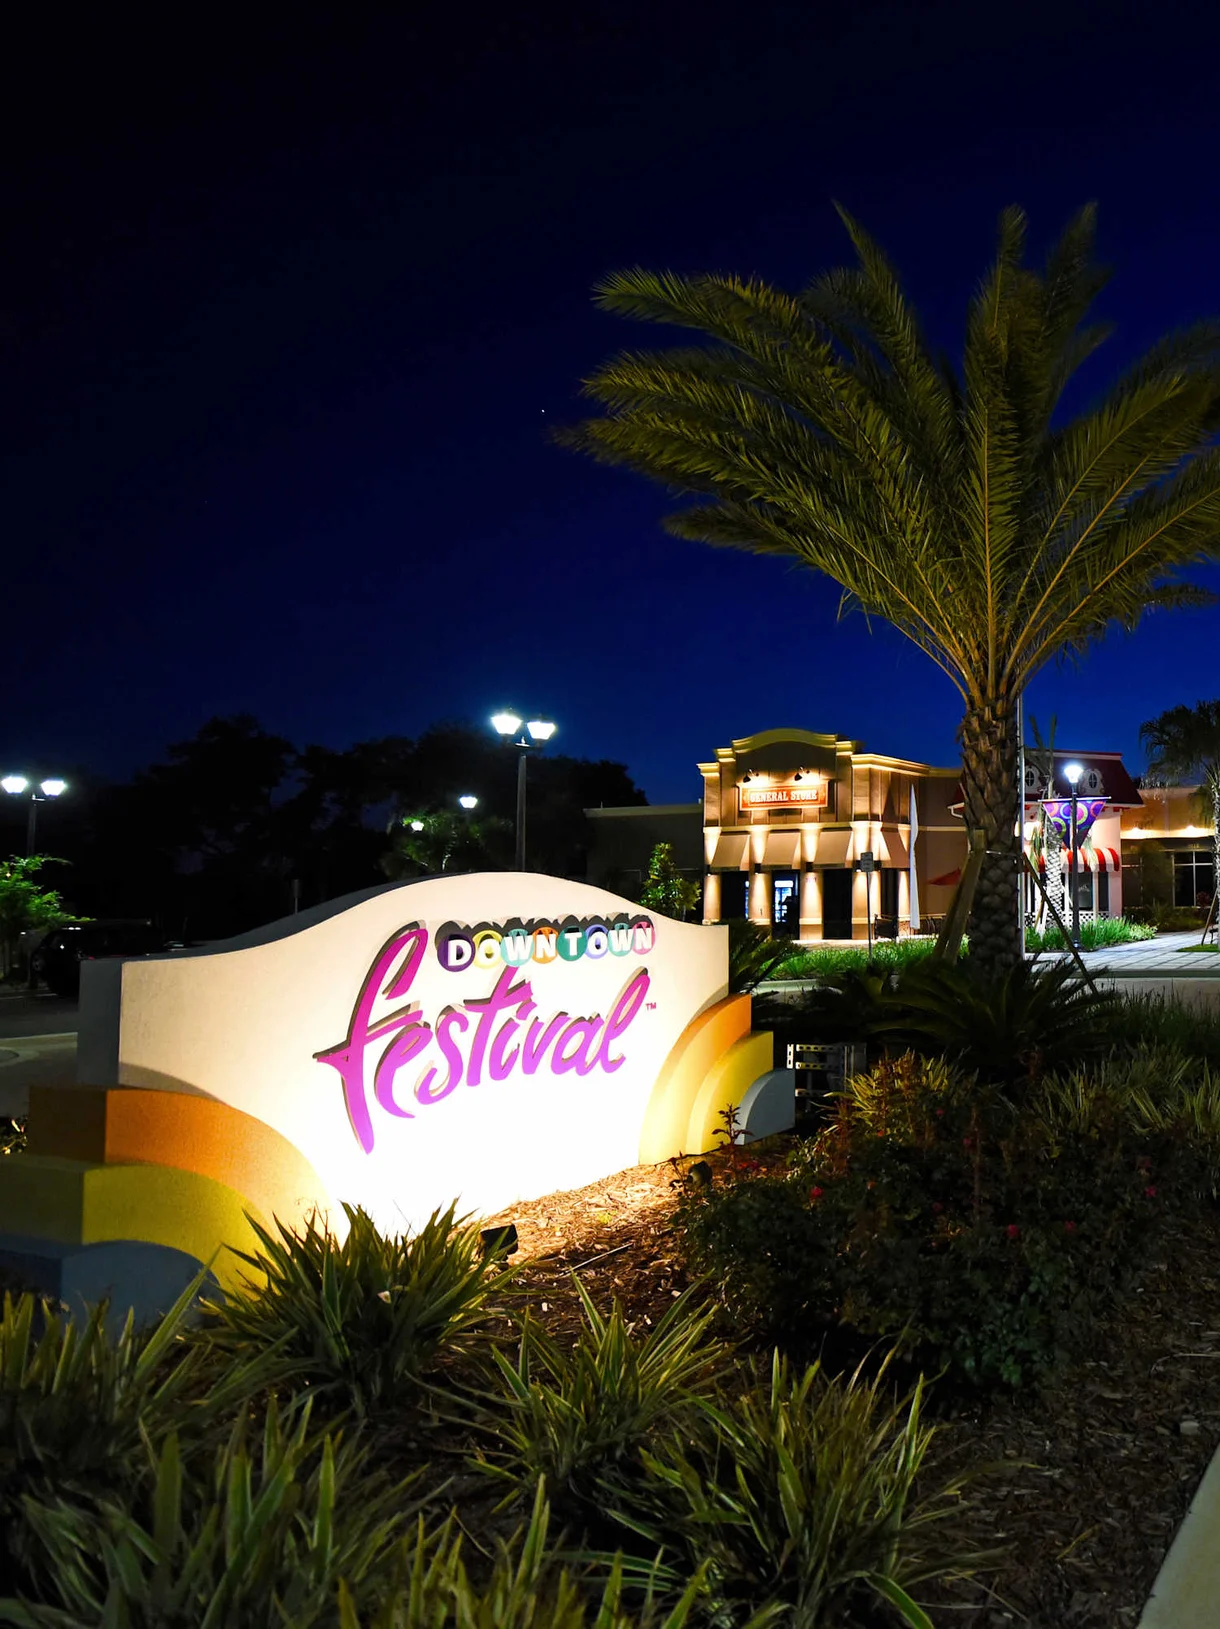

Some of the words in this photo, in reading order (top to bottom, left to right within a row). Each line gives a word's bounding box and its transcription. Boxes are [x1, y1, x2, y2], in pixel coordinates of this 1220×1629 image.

[750, 790, 788, 802] GENERAL
[790, 789, 817, 801] STORE
[446, 926, 652, 968] DOWNTOWN
[313, 925, 651, 1155] festival
